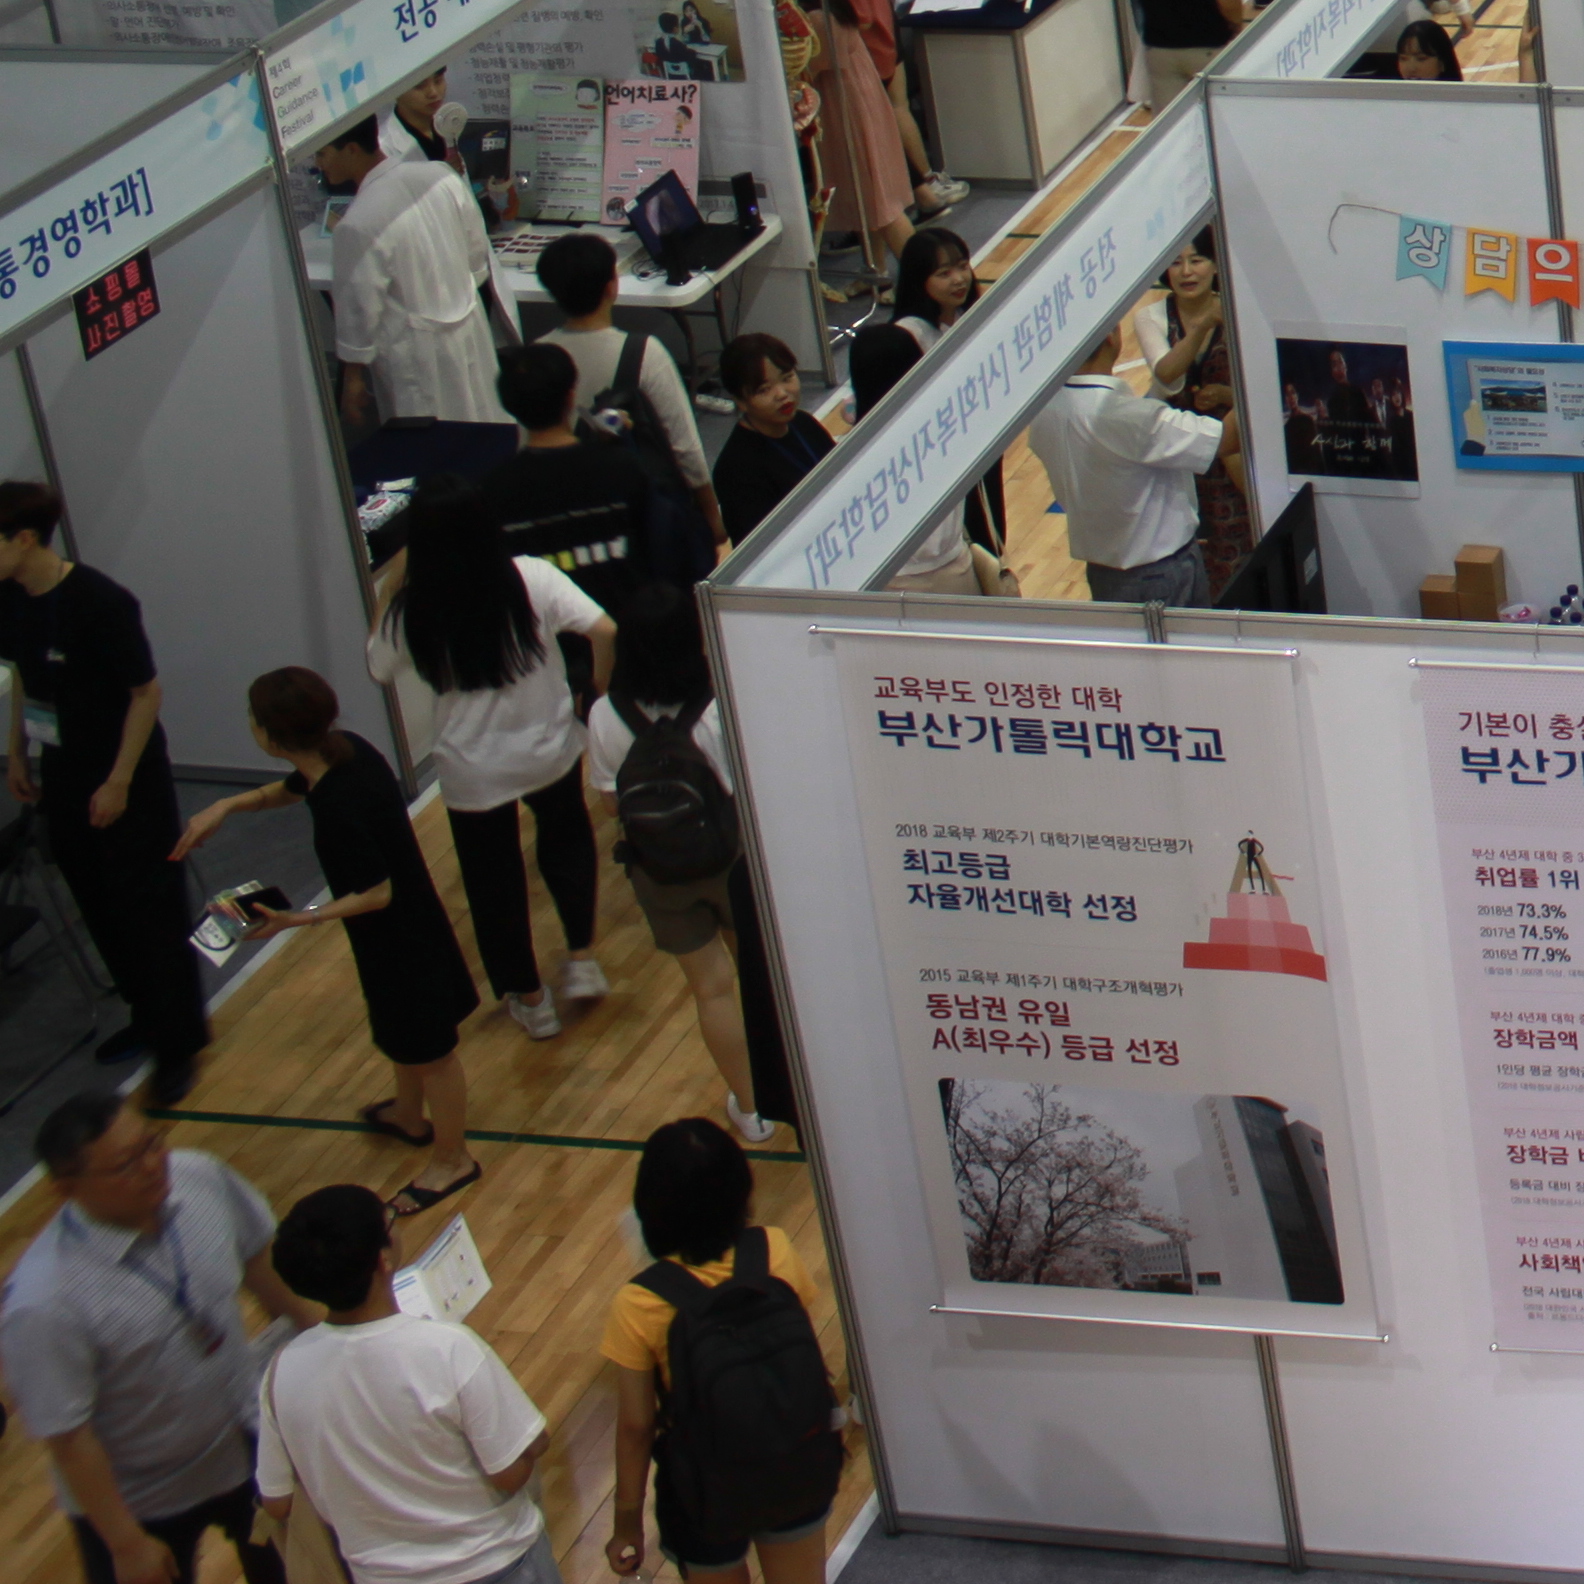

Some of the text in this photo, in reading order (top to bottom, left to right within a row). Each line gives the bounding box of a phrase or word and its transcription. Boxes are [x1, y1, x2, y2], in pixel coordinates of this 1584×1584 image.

[272, 76, 301, 99] Career
[605, 83, 697, 106] 언어치료사?
[277, 87, 318, 117] Guidance
[281, 111, 315, 140] Festival
[874, 676, 1123, 713] 교육부도 인정한 대학
[878, 709, 1227, 763] 부산가톨릭대학교
[1458, 711, 1538, 739] 기본이
[896, 824, 1194, 854] 2018 교육부 제2주기 대학기본역량진단평가
[903, 849, 1011, 881] 최고등급
[1471, 848, 1495, 861] 부산
[1499, 849, 1530, 862] 4년제
[1534, 850, 1557, 863] 대학
[1562, 852, 1573, 863] 중
[1475, 866, 1580, 890] 취업률 1위
[907, 883, 1138, 923] 자율개선대학 선정
[1477, 902, 1567, 919] 2018년 73.3%
[1480, 924, 1569, 941] 2017년 74.5%
[1482, 946, 1571, 963] 2016년 77.9%
[920, 968, 1184, 998] 2015 교육부 제1주기 대학구조개혁평가
[925, 993, 1071, 1027] 동남권 유일
[1551, 1013, 1575, 1024] 대학
[932, 1025, 1180, 1066] A(최우수) 등급 선정
[1493, 1028, 1578, 1051] 장학금액
[1506, 1144, 1569, 1166] 장학금
[1522, 1286, 1545, 1299] 전국
